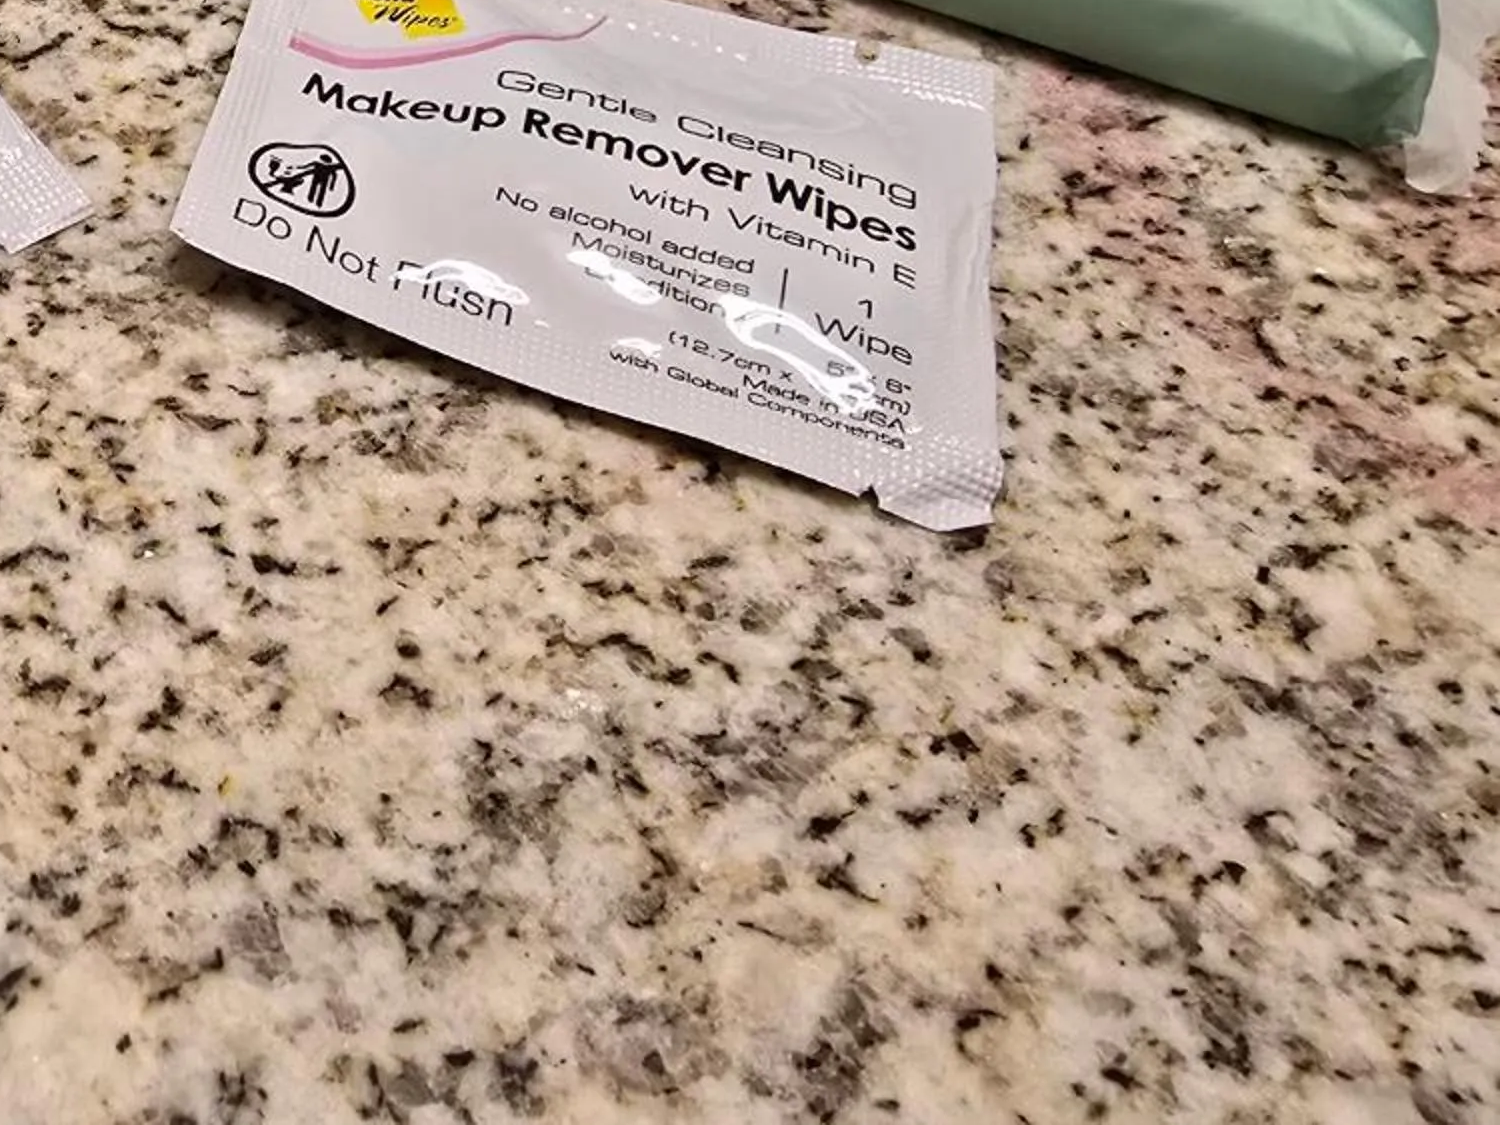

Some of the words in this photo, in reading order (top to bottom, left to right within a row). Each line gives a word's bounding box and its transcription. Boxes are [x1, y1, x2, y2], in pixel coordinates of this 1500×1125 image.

[301, 72, 507, 133] Makeup
[521, 108, 752, 193] Remover
[766, 170, 919, 253] Wipes
[496, 69, 659, 124] Gentle
[676, 114, 918, 210] Cleansing
[232, 197, 293, 241] Do
[305, 224, 382, 284] Not
[495, 185, 539, 214] No
[548, 205, 652, 246] alcohol
[660, 239, 756, 275] added
[571, 231, 751, 299] Moisturizes
[628, 183, 710, 223] with
[726, 206, 876, 274] Vitamin
[893, 262, 918, 290] E
[815, 311, 914, 366] Wipe
[858, 298, 875, 321] 1
[608, 348, 660, 374] with
[667, 364, 739, 400] Global
[746, 391, 906, 451] Components
[668, 329, 772, 377] (12.7cm
[779, 369, 794, 383] x
[742, 373, 811, 407] Made
[818, 396, 841, 415] in
[850, 405, 908, 435] USA
